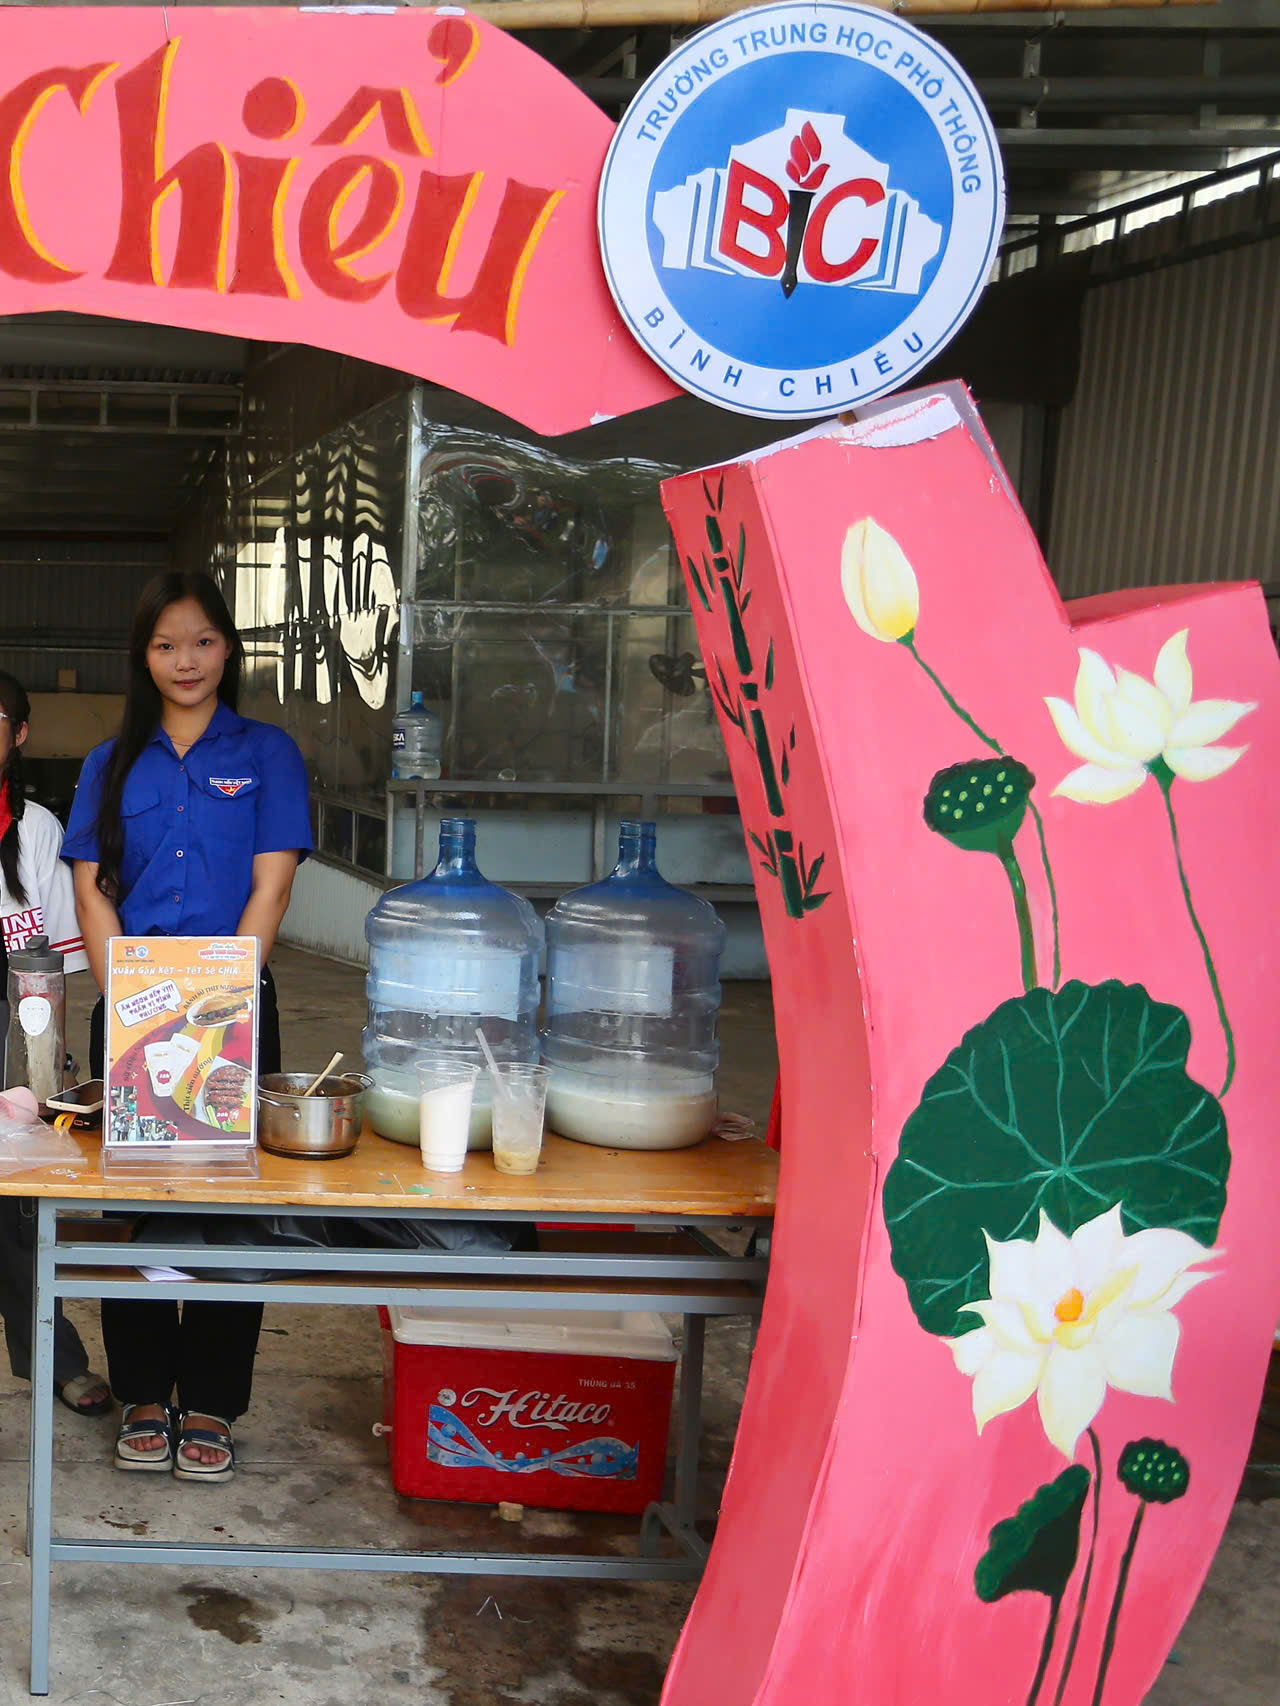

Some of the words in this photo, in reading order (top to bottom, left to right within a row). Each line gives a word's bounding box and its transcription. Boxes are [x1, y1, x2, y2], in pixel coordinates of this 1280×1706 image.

[636, 48, 729, 141] TRƯỜNG
[732, 23, 827, 56] TRUNG
[835, 25, 893, 60] HỌC
[894, 51, 945, 99] PHỔ
[938, 98, 982, 194] THÔNG
[644, 306, 743, 387] BÌNH
[779, 331, 924, 397] CHIỂU
[461, 1387, 611, 1431] Hitaco
